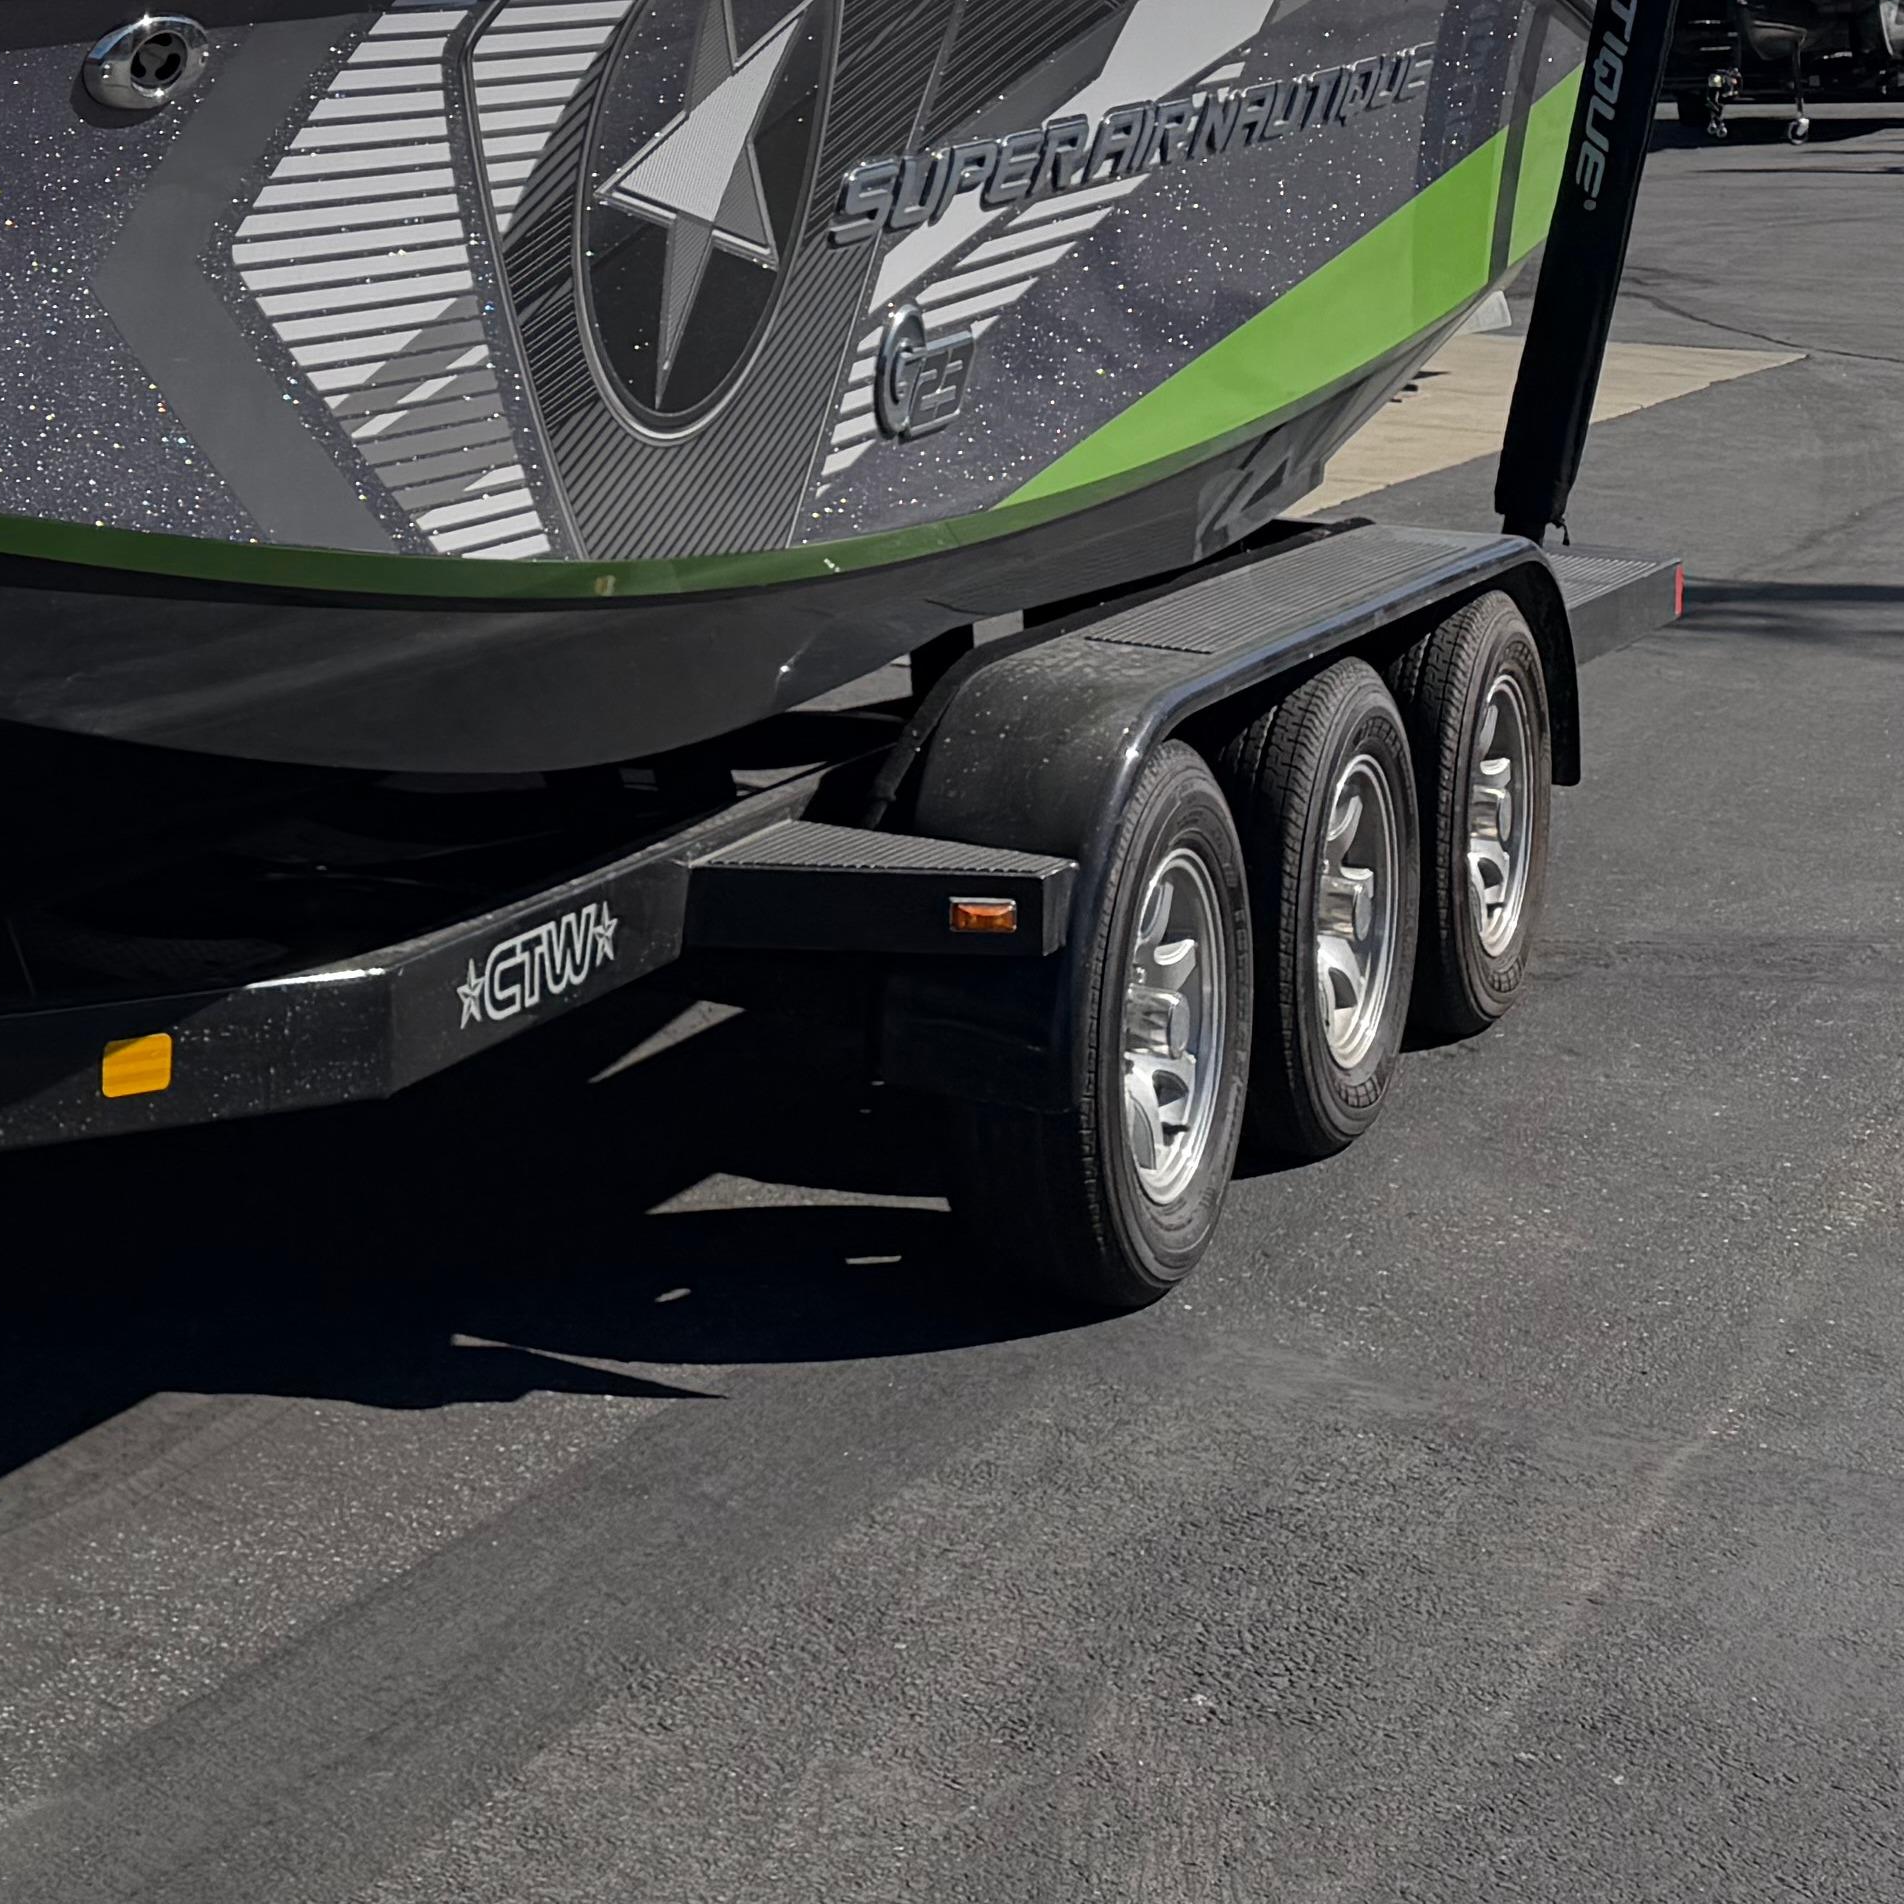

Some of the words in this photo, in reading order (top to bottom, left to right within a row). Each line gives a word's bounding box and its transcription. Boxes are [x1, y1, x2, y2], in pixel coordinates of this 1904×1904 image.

[827, 116, 1090, 249] SUPER
[1082, 100, 1193, 184] AIR
[1187, 42, 1434, 159] NAUTIQUE
